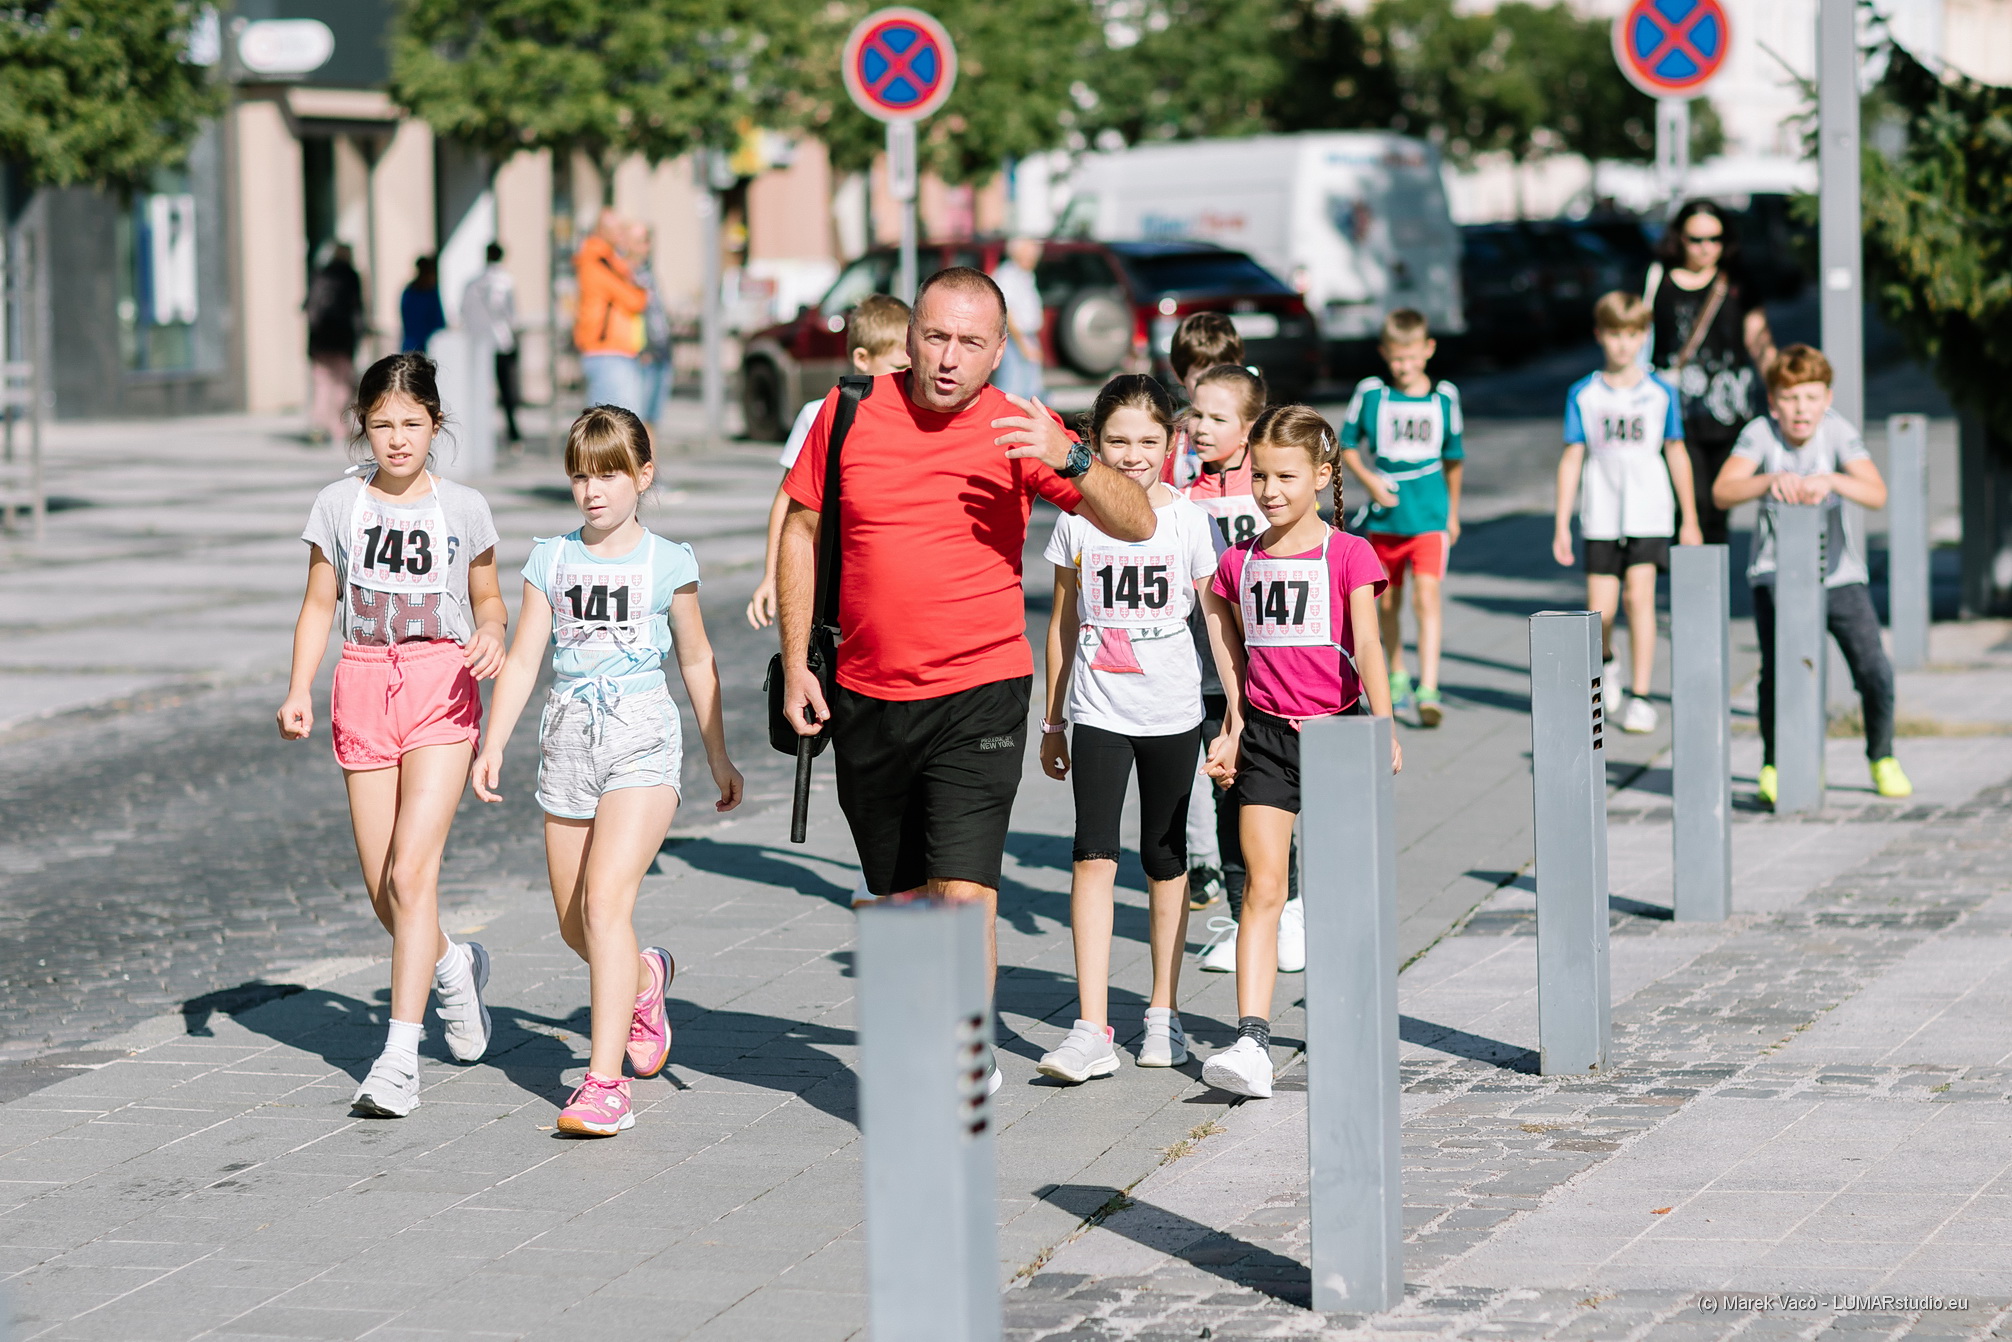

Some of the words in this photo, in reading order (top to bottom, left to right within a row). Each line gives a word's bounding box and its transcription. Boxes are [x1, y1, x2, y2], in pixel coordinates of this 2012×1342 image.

[1393, 418, 1431, 441] 140
[1602, 417, 1643, 441] 146
[363, 525, 432, 575] 143
[564, 585, 629, 630] 141
[1096, 565, 1168, 609] 145
[1250, 581, 1309, 625] 147
[980, 742, 997, 750] NEW
[997, 740, 1015, 748] YORK
